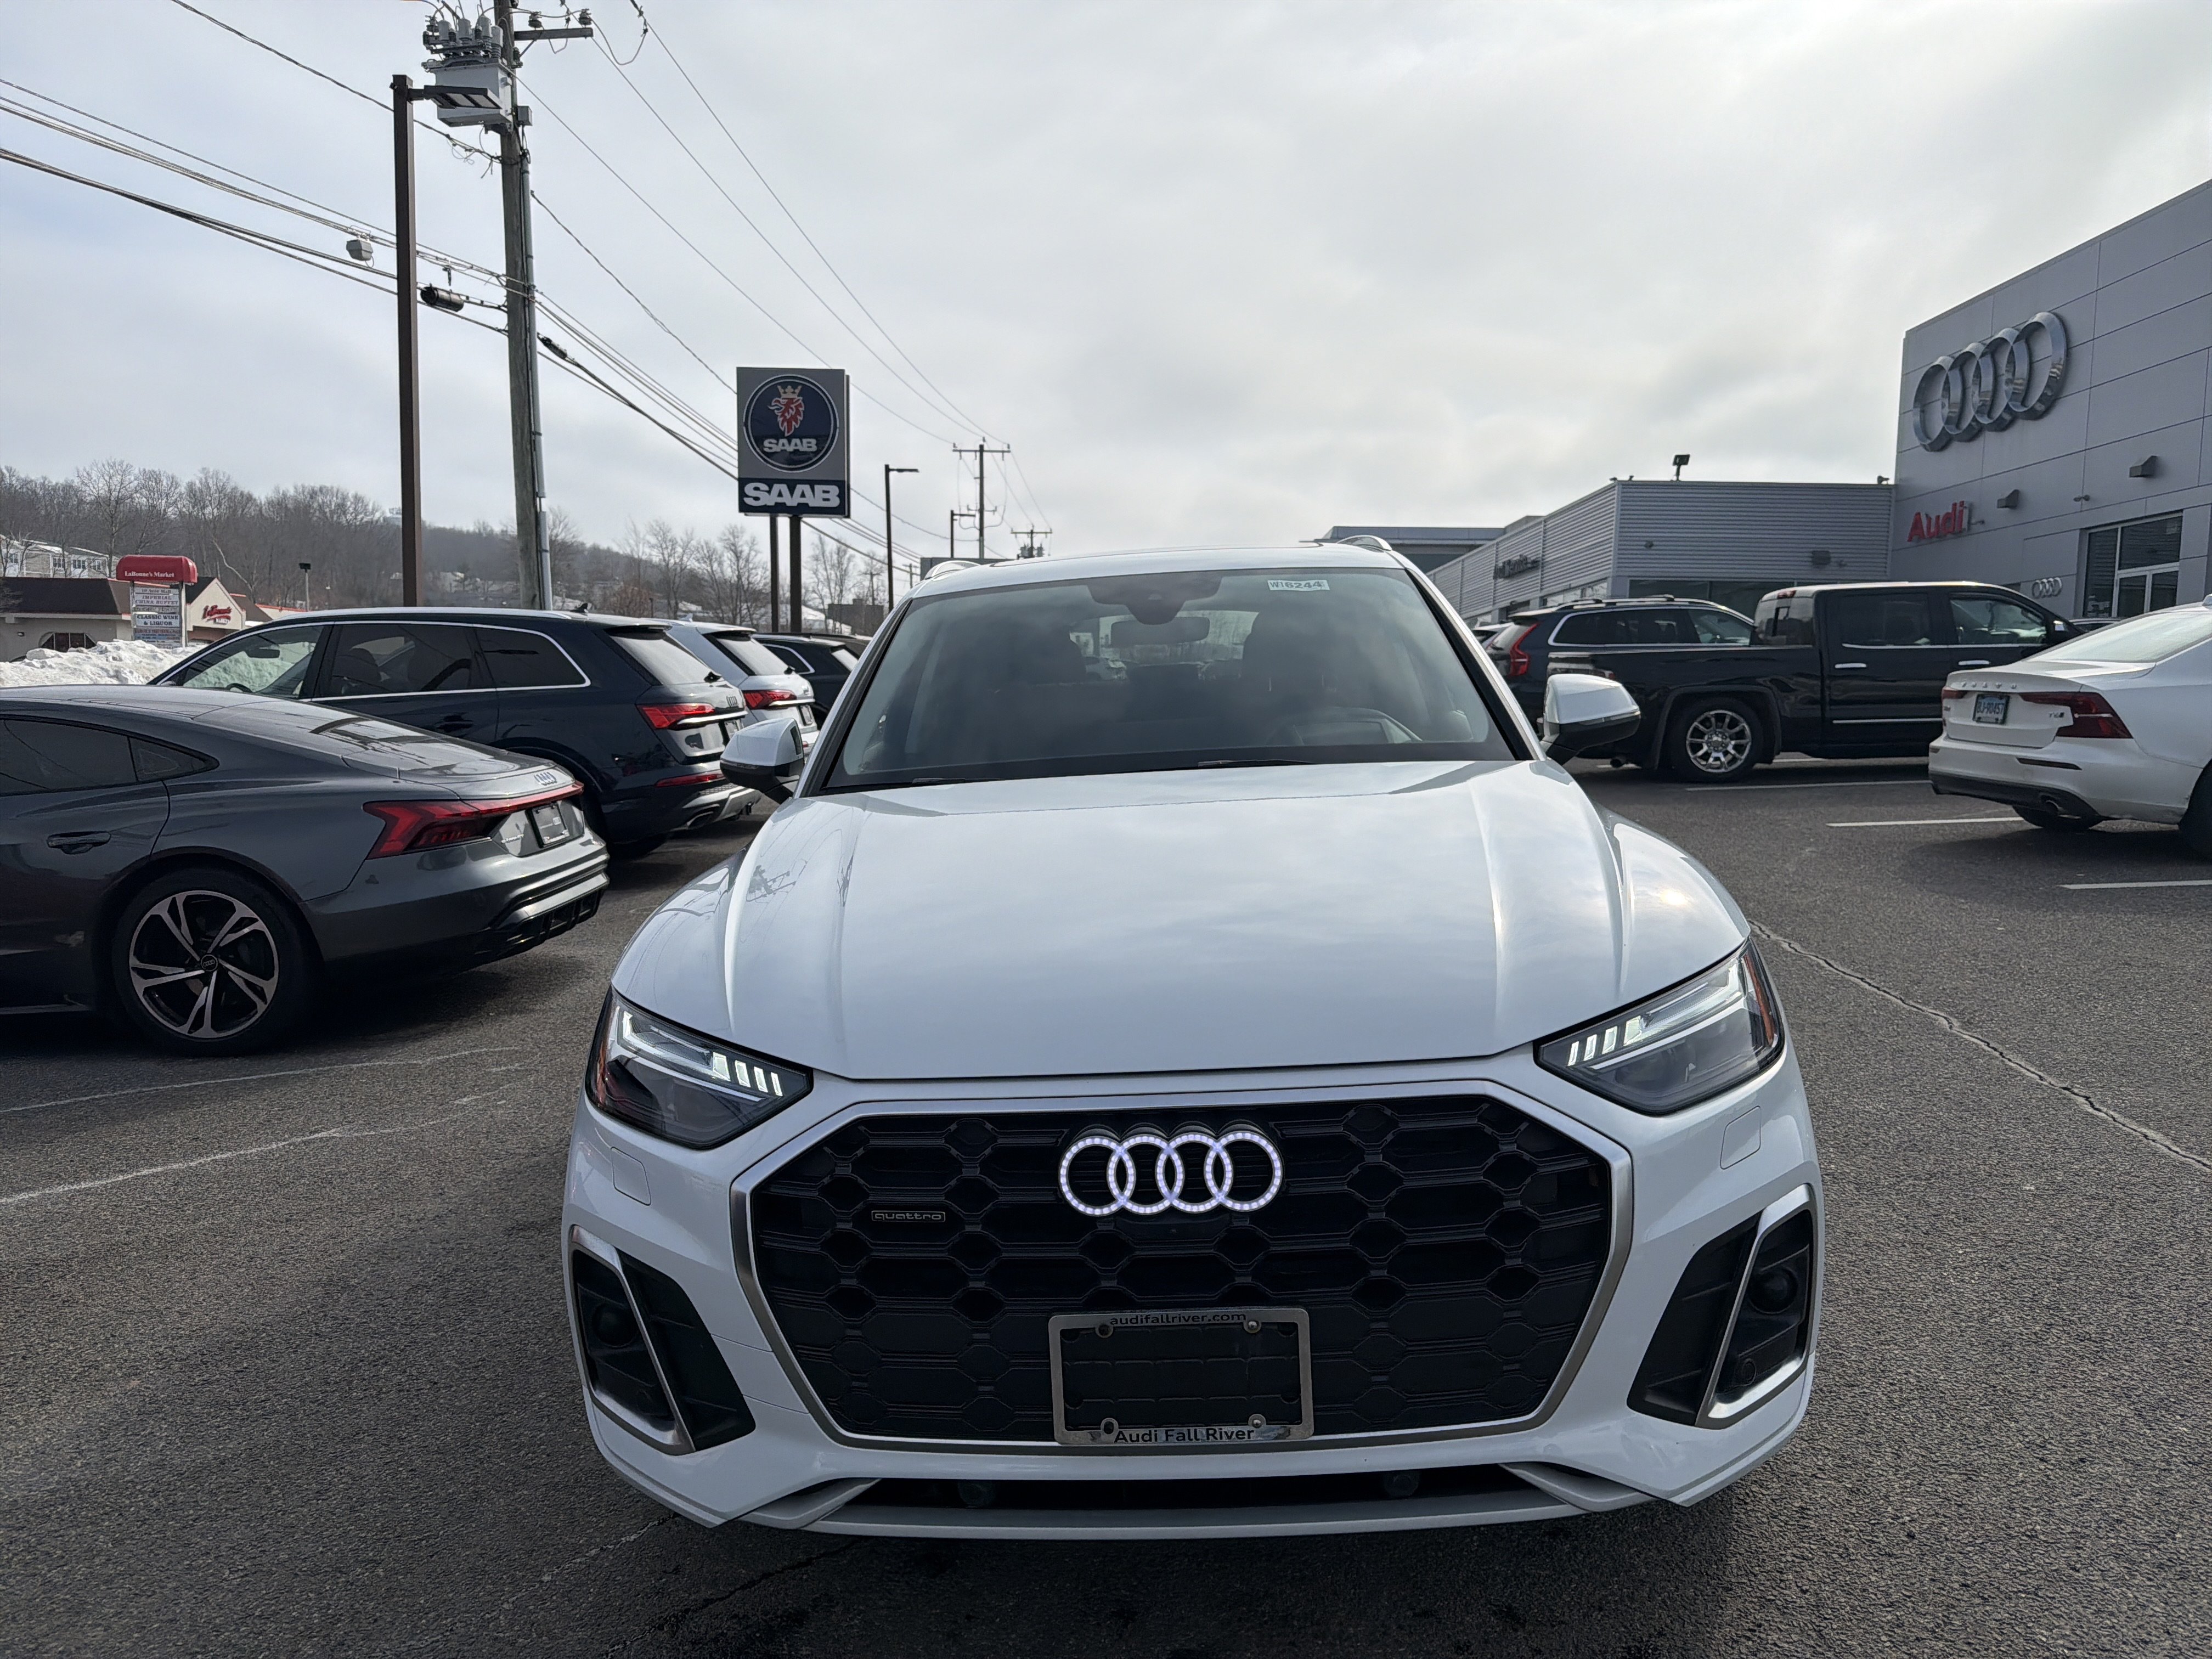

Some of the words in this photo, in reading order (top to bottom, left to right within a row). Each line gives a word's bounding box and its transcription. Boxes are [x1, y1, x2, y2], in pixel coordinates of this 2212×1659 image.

[763, 438, 817, 453] SAAB
[743, 482, 840, 507] SAAB
[1907, 500, 1964, 542] Audi
[874, 1212, 942, 1221] quattro
[1110, 1313, 1246, 1325] audifallriver.com
[1114, 1429, 1158, 1443] Audi
[1165, 1429, 1200, 1442] Fall
[1206, 1427, 1254, 1441] River
